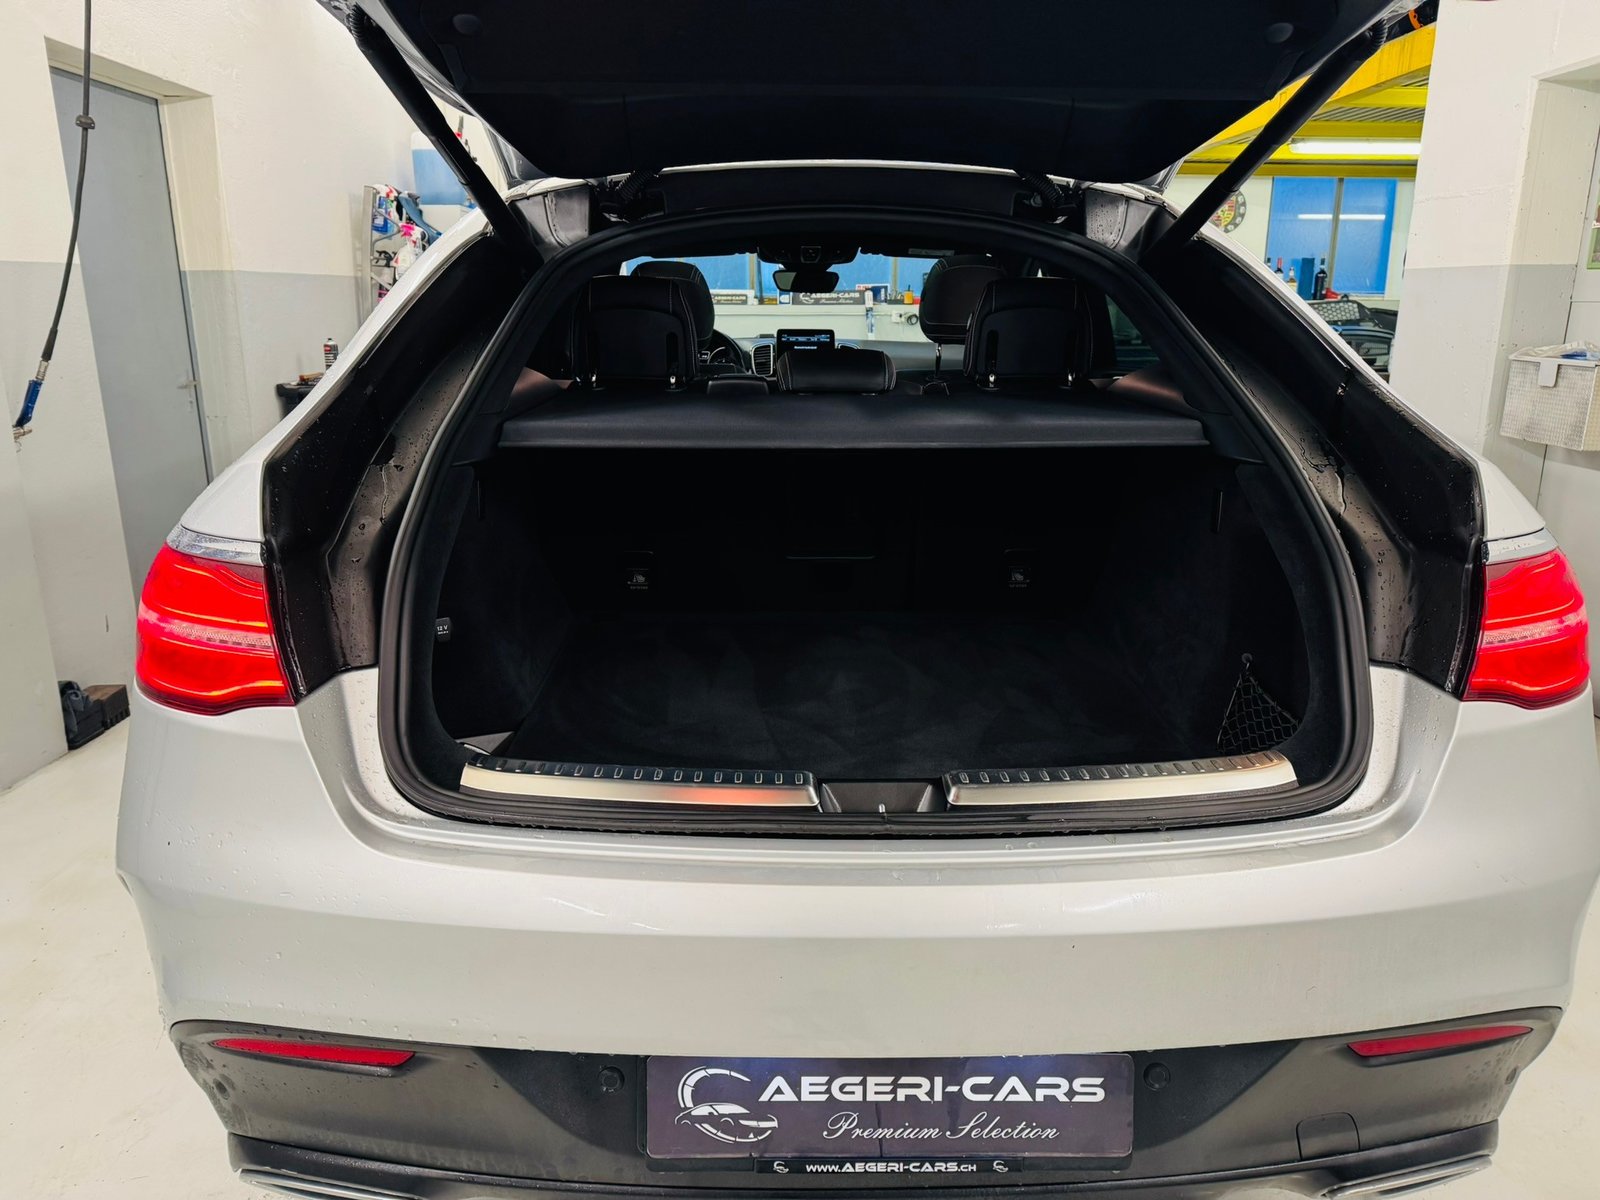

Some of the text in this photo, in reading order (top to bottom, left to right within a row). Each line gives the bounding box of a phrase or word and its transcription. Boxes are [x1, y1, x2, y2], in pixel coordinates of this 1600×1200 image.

[758, 1075, 1105, 1103] AEGERI-CARS
[823, 1111, 1060, 1140] Premium Selection
